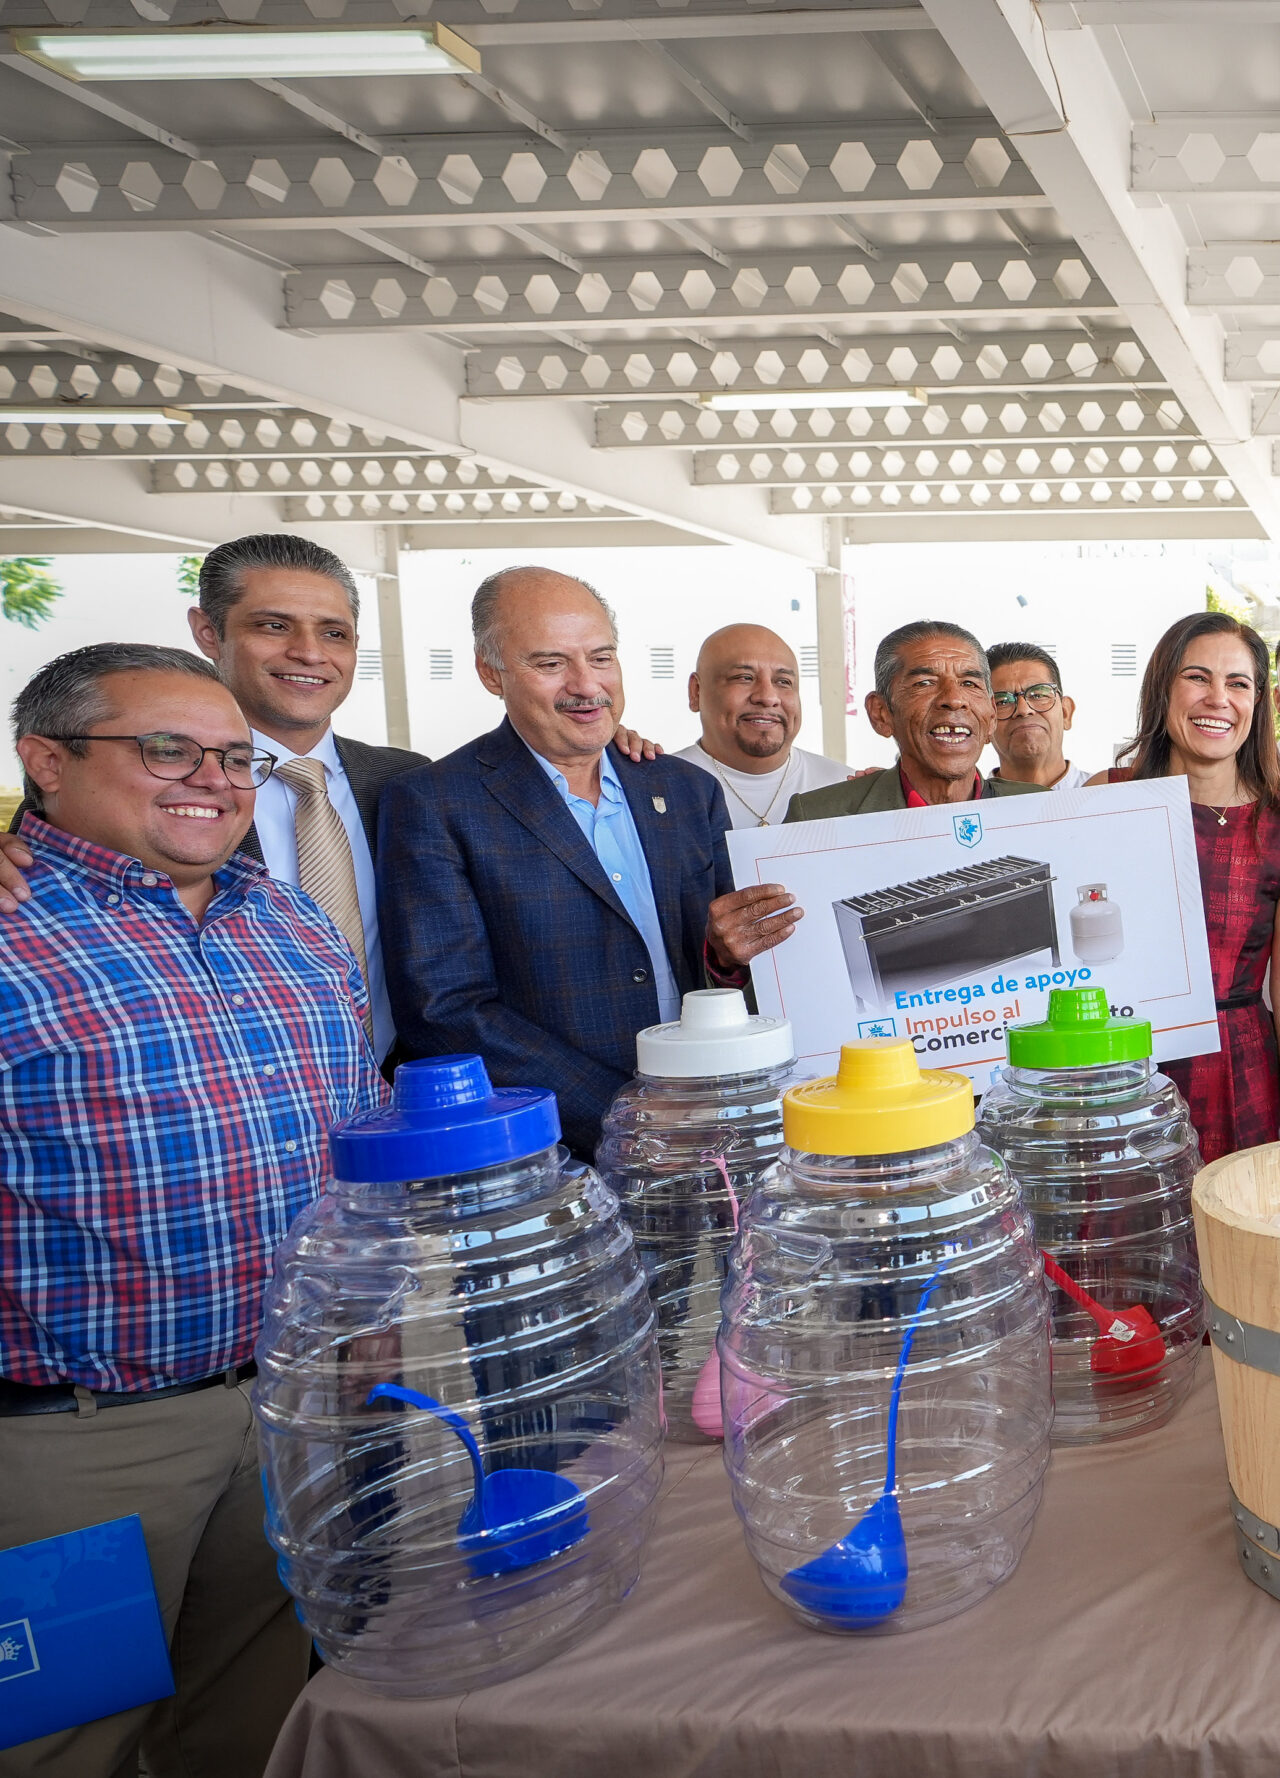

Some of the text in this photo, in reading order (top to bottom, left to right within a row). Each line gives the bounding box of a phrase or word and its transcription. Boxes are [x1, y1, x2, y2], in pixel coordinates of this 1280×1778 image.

[894, 967, 1092, 1010] Entrega de apoyo
[905, 999, 1021, 1035] Impulso al
[911, 1004, 1134, 1054] Comerci to
